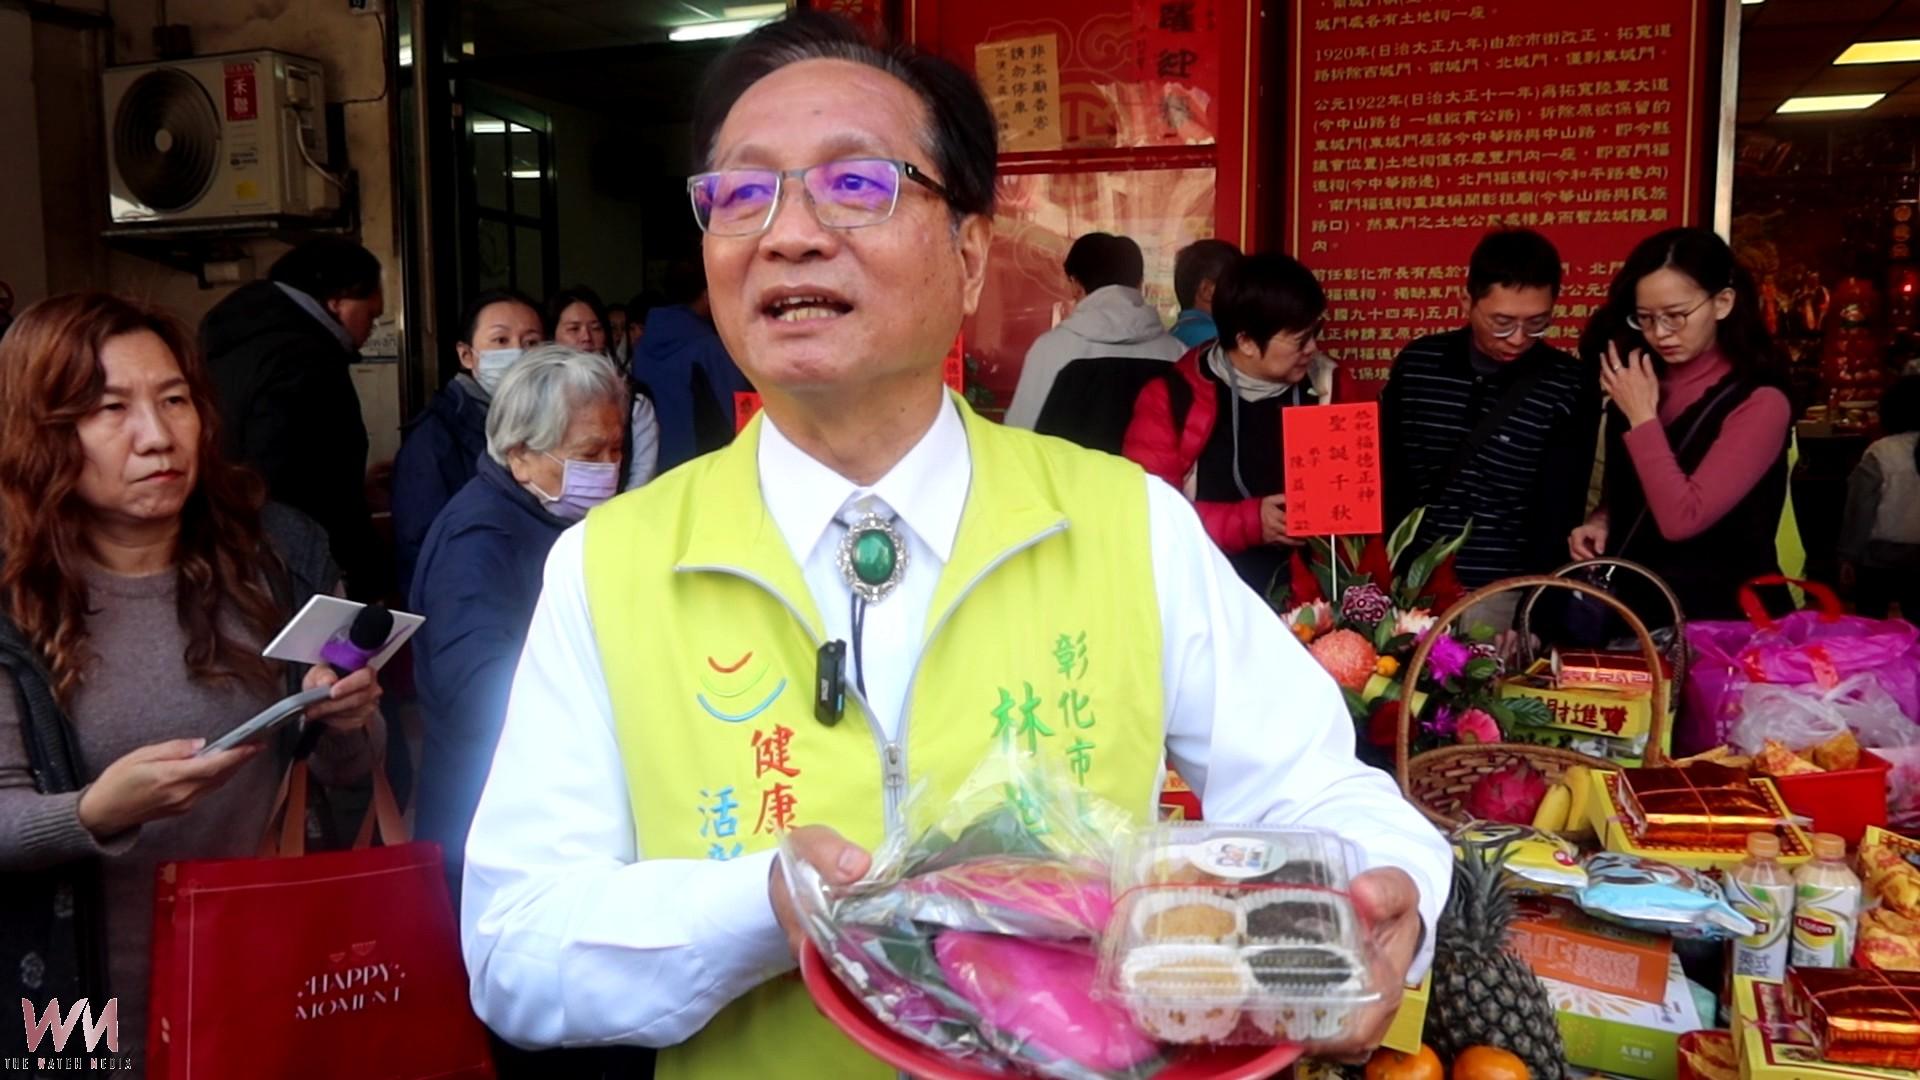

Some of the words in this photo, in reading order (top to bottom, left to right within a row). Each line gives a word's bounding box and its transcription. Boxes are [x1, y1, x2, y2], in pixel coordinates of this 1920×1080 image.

[1010, 47, 1027, 114] 請勿停車
[1324, 286, 1467, 301] 福德祠，獨缺東門
[1318, 305, 1469, 322] 國九十四年)五月
[1328, 414, 1353, 521] 聖誕千秋
[1052, 630, 1098, 832] 彰化市
[1537, 695, 1629, 735] 財進寶
[750, 723, 801, 837] 健康
[1797, 917, 1834, 936] Lipton
[310, 963, 389, 996] HAPPY
[295, 986, 400, 1020] MOMENT
